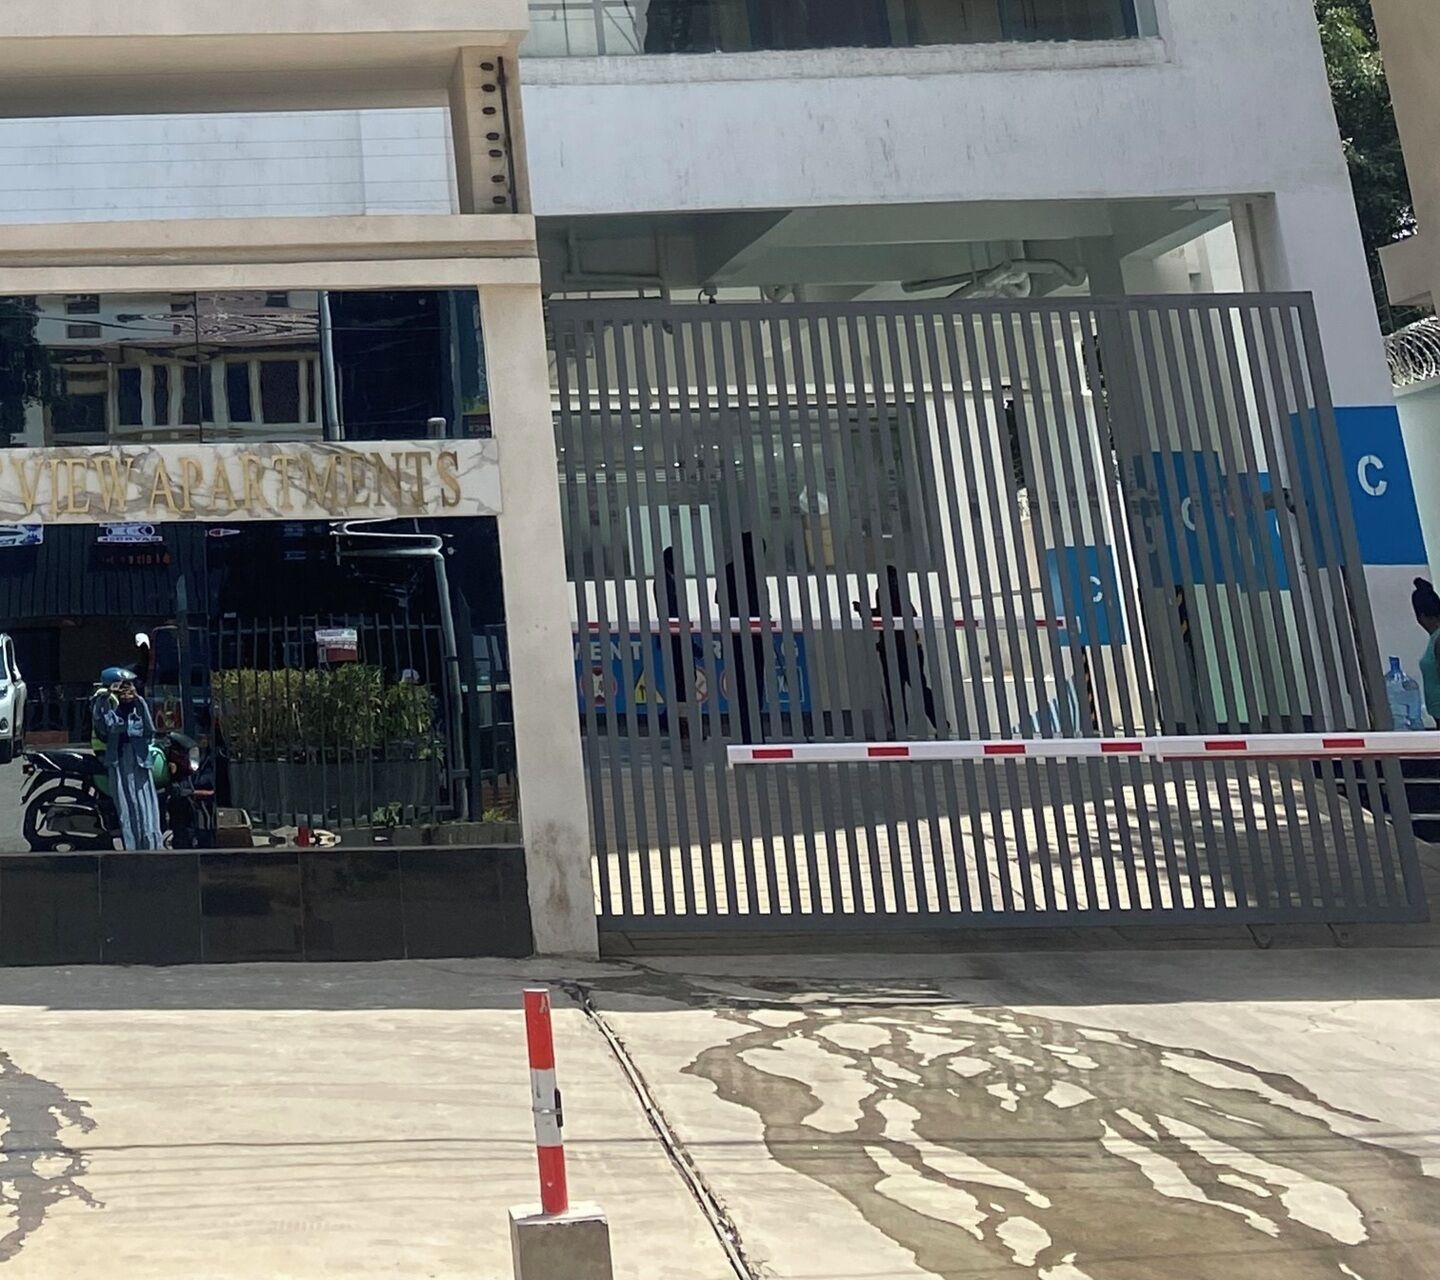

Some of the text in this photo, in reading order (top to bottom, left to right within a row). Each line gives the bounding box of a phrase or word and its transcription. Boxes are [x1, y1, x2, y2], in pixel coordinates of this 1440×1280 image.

[13, 454, 134, 516] VIEW
[149, 450, 462, 513] APARTMENTS
[1357, 454, 1387, 496] C
